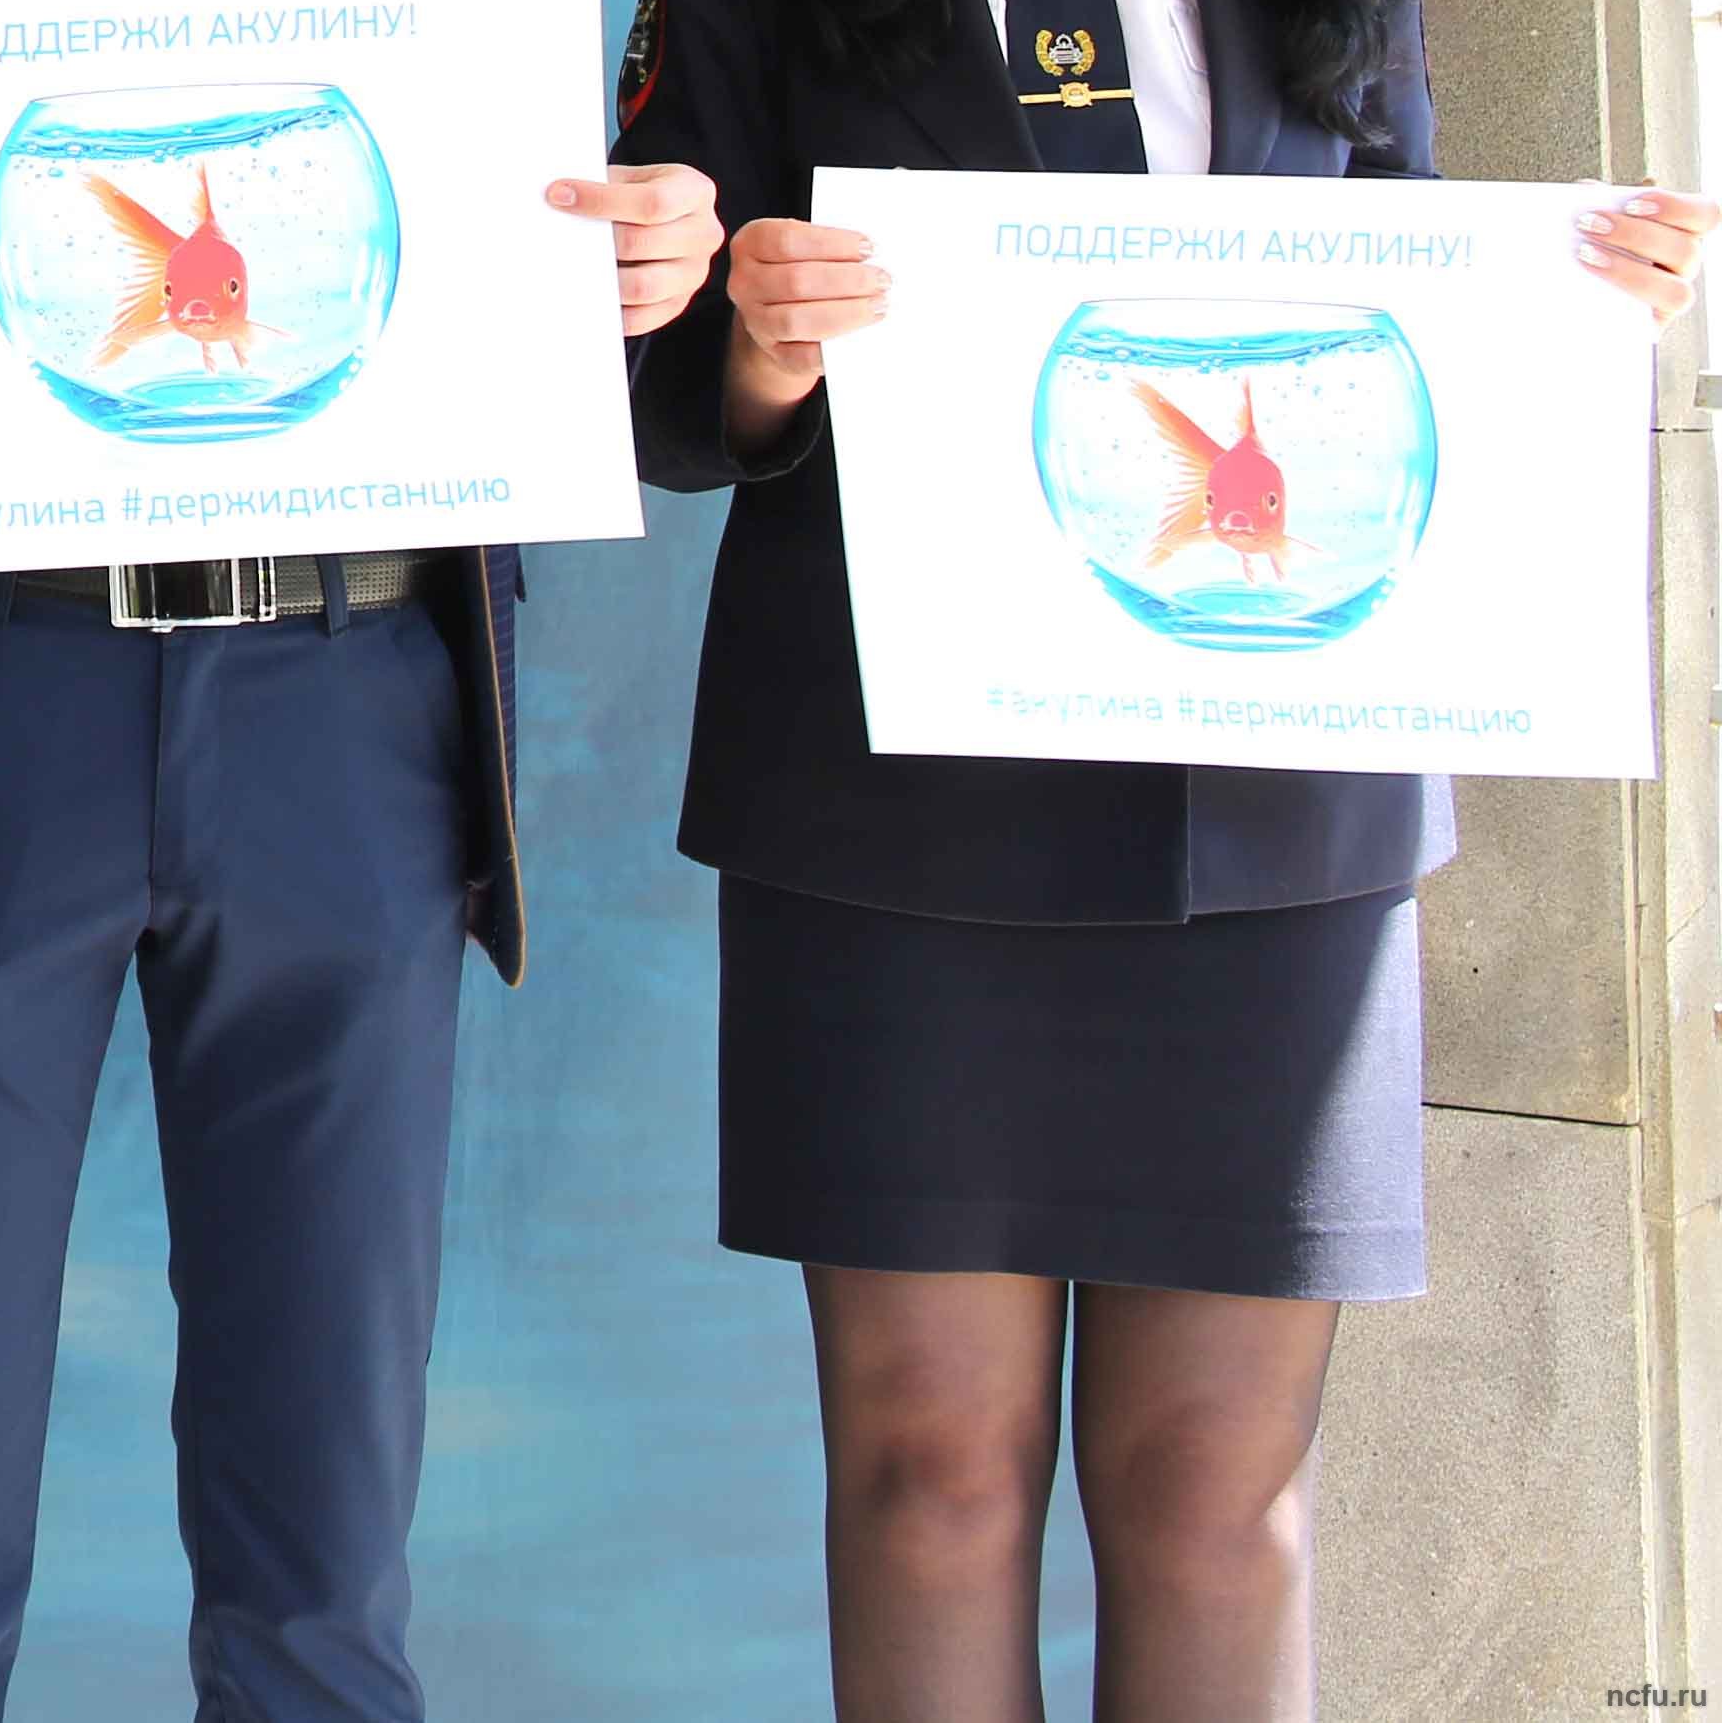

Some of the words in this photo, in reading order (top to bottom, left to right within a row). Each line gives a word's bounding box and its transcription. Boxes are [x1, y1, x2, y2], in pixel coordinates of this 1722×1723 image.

[208, 4, 418, 47] АКУЛИНУ!
[995, 222, 1245, 264] ПОДДЕРЖИ
[1262, 229, 1473, 268] АКУЛИНУ!
[122, 477, 512, 527] #держидистанцию
[1177, 693, 1532, 737] #держидистанцию
